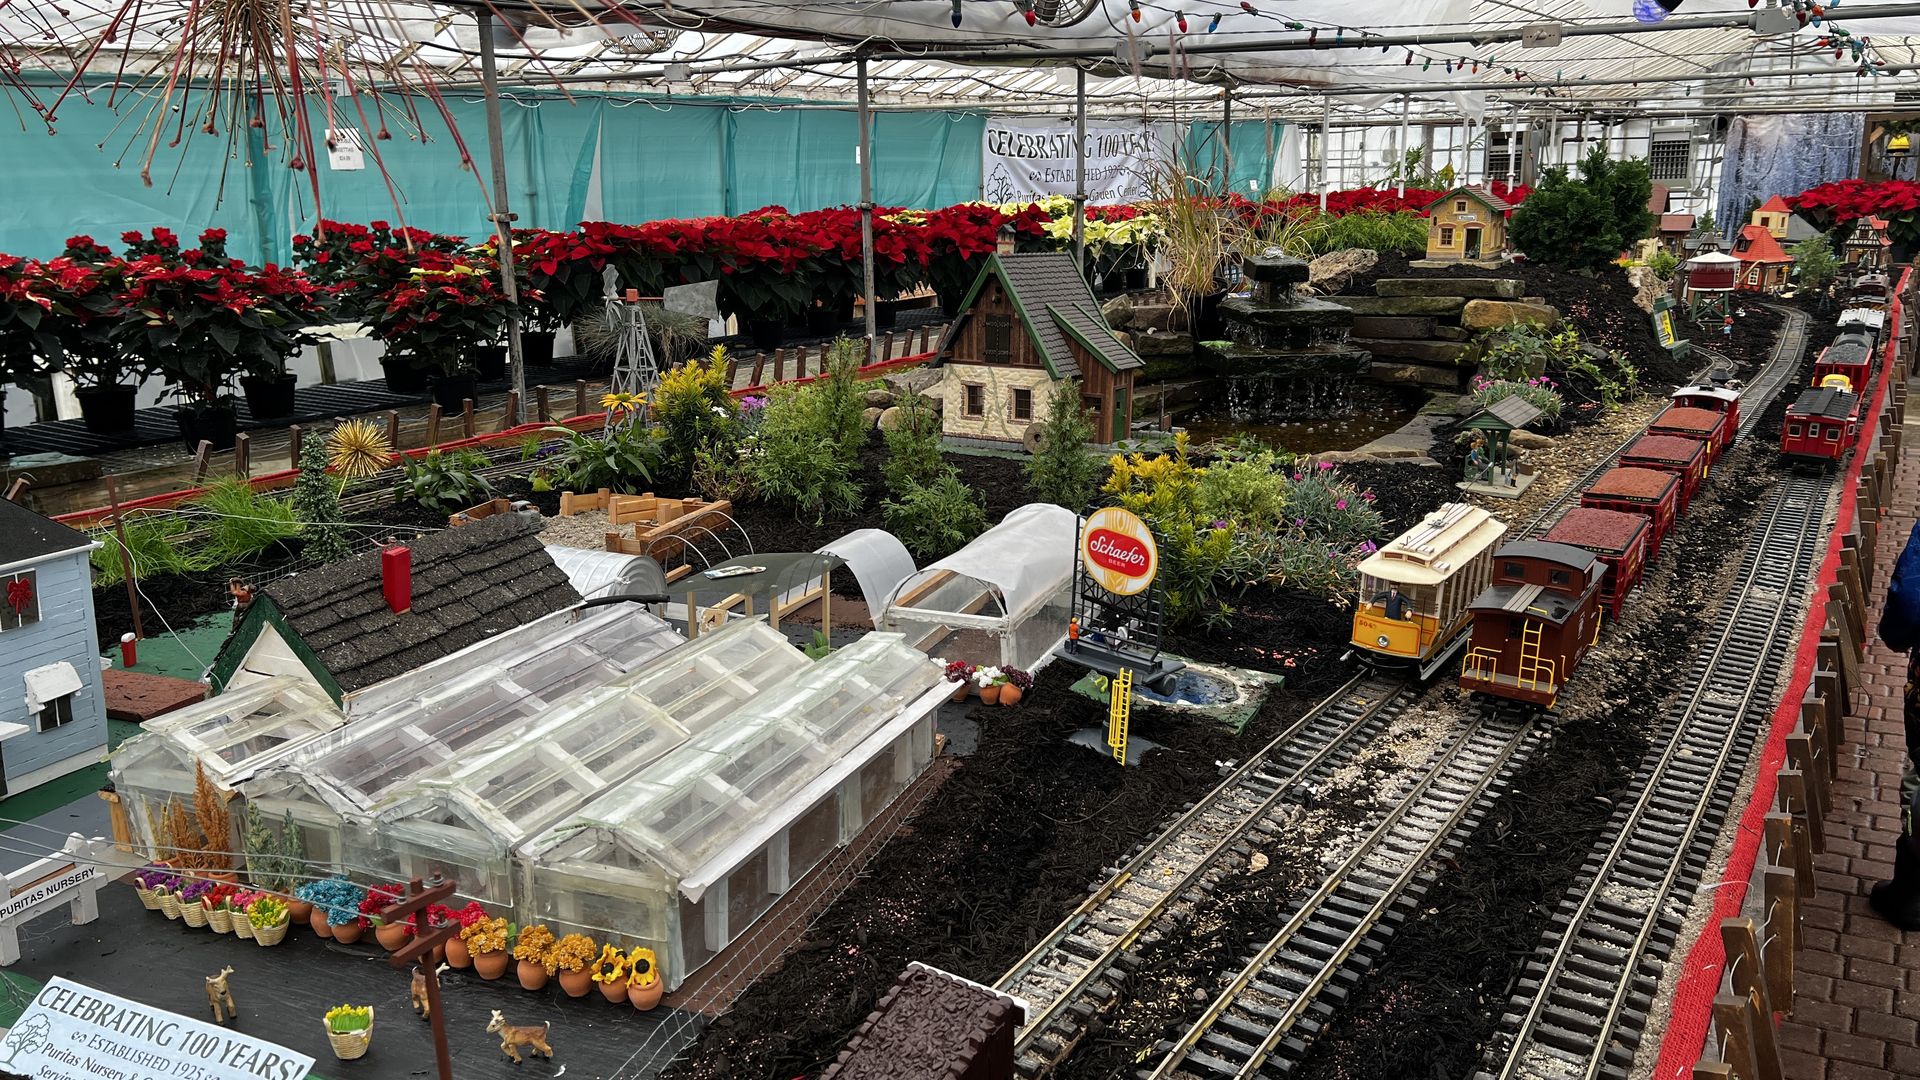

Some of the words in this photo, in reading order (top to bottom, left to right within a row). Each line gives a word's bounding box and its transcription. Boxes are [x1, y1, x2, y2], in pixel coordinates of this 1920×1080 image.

[988, 129, 1092, 158] CELEBRATING
[1097, 134, 1119, 157] 100
[1045, 168, 1101, 182] ESTABLHED
[1090, 535, 1145, 566] Schaefer
[1108, 558, 1126, 568] BEER
[0, 890, 44, 919] PURITAS
[45, 867, 95, 896] NURSERY
[38, 985, 179, 1047] CELEBRATING
[178, 1030, 220, 1059] 100
[218, 1040, 305, 1080] YEARS!
[36, 1064, 76, 1080] Servi
[41, 1042, 81, 1067] Puritas
[81, 1056, 127, 1080] Nursery
[87, 1034, 171, 1072] ESTABLISHED
[171, 1062, 206, 1080] 1925
